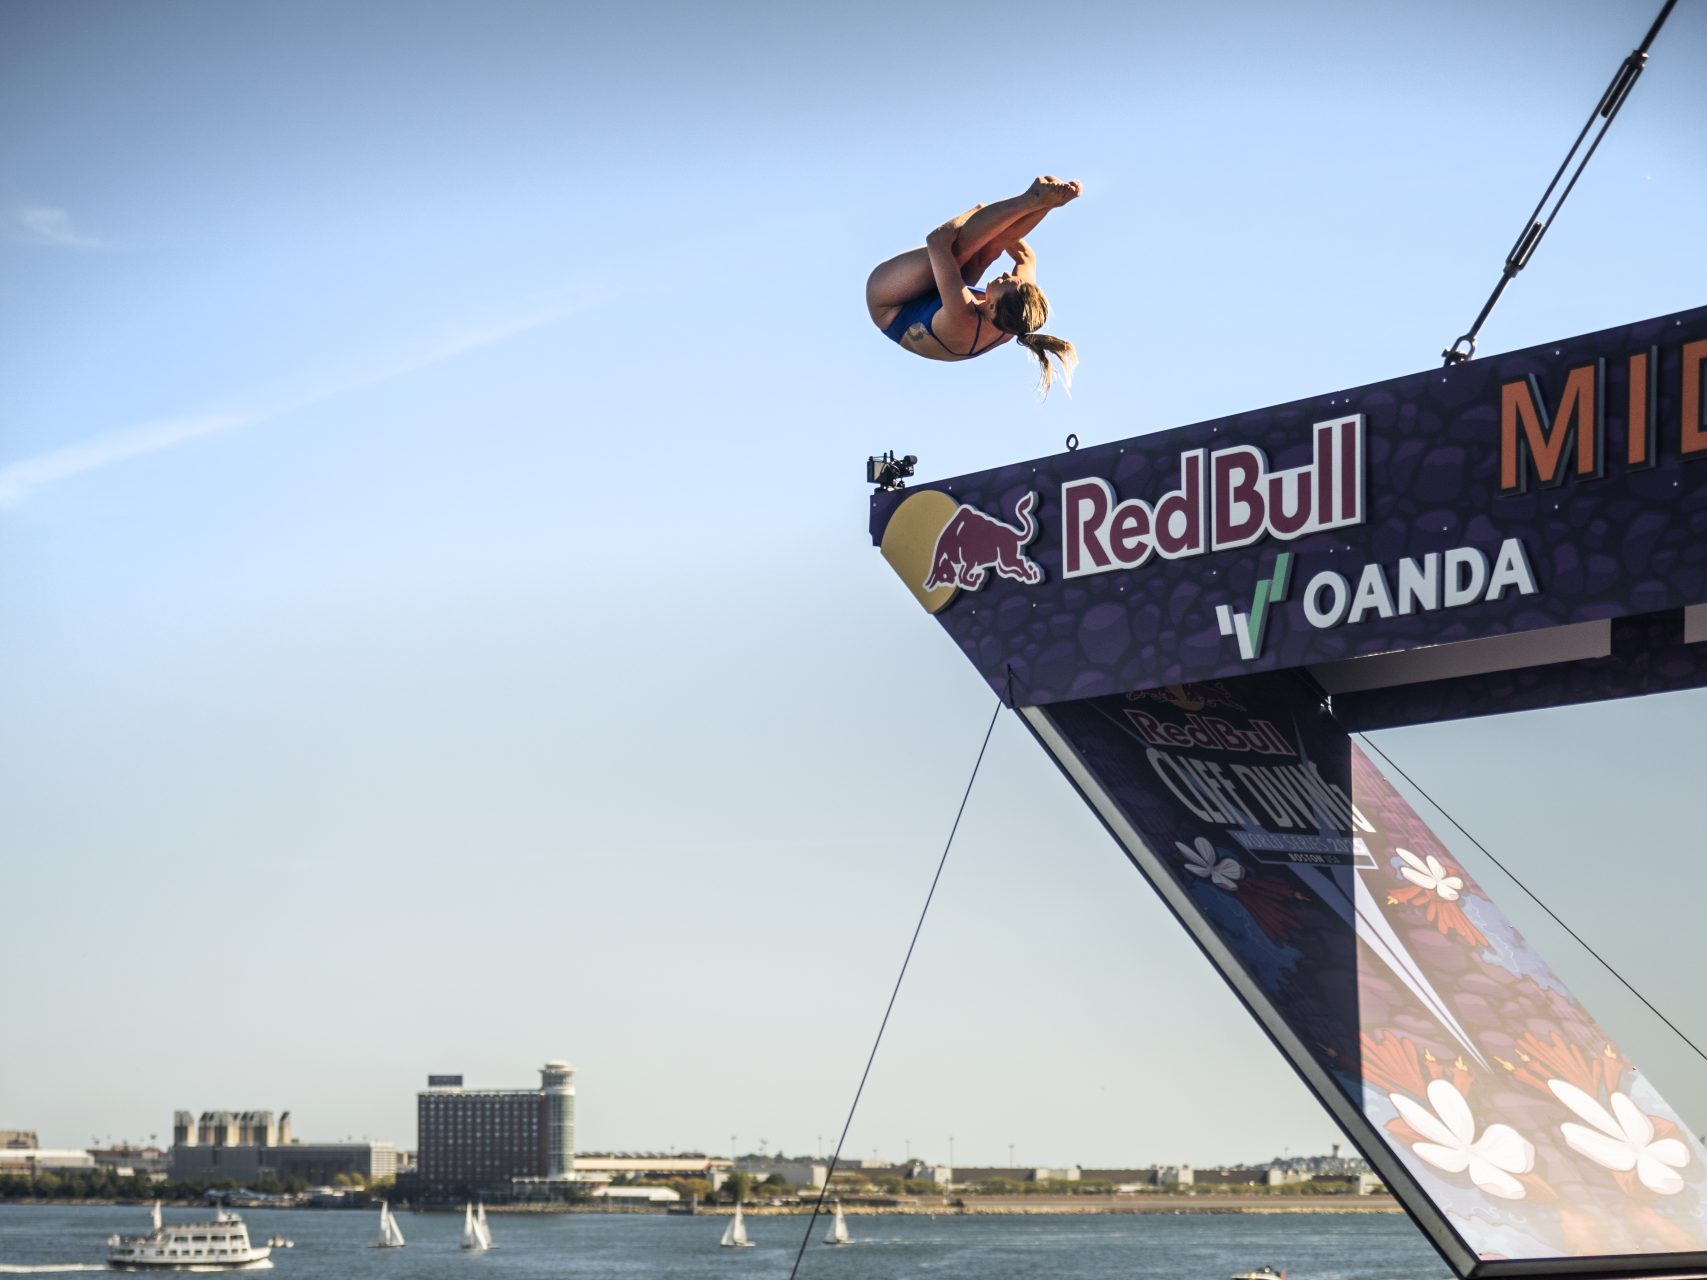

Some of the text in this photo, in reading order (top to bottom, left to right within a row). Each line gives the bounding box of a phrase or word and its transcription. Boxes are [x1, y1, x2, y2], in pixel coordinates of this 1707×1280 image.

[1303, 538, 1539, 629] OANDA
[1146, 747, 1376, 833] CLIFF DIVING
